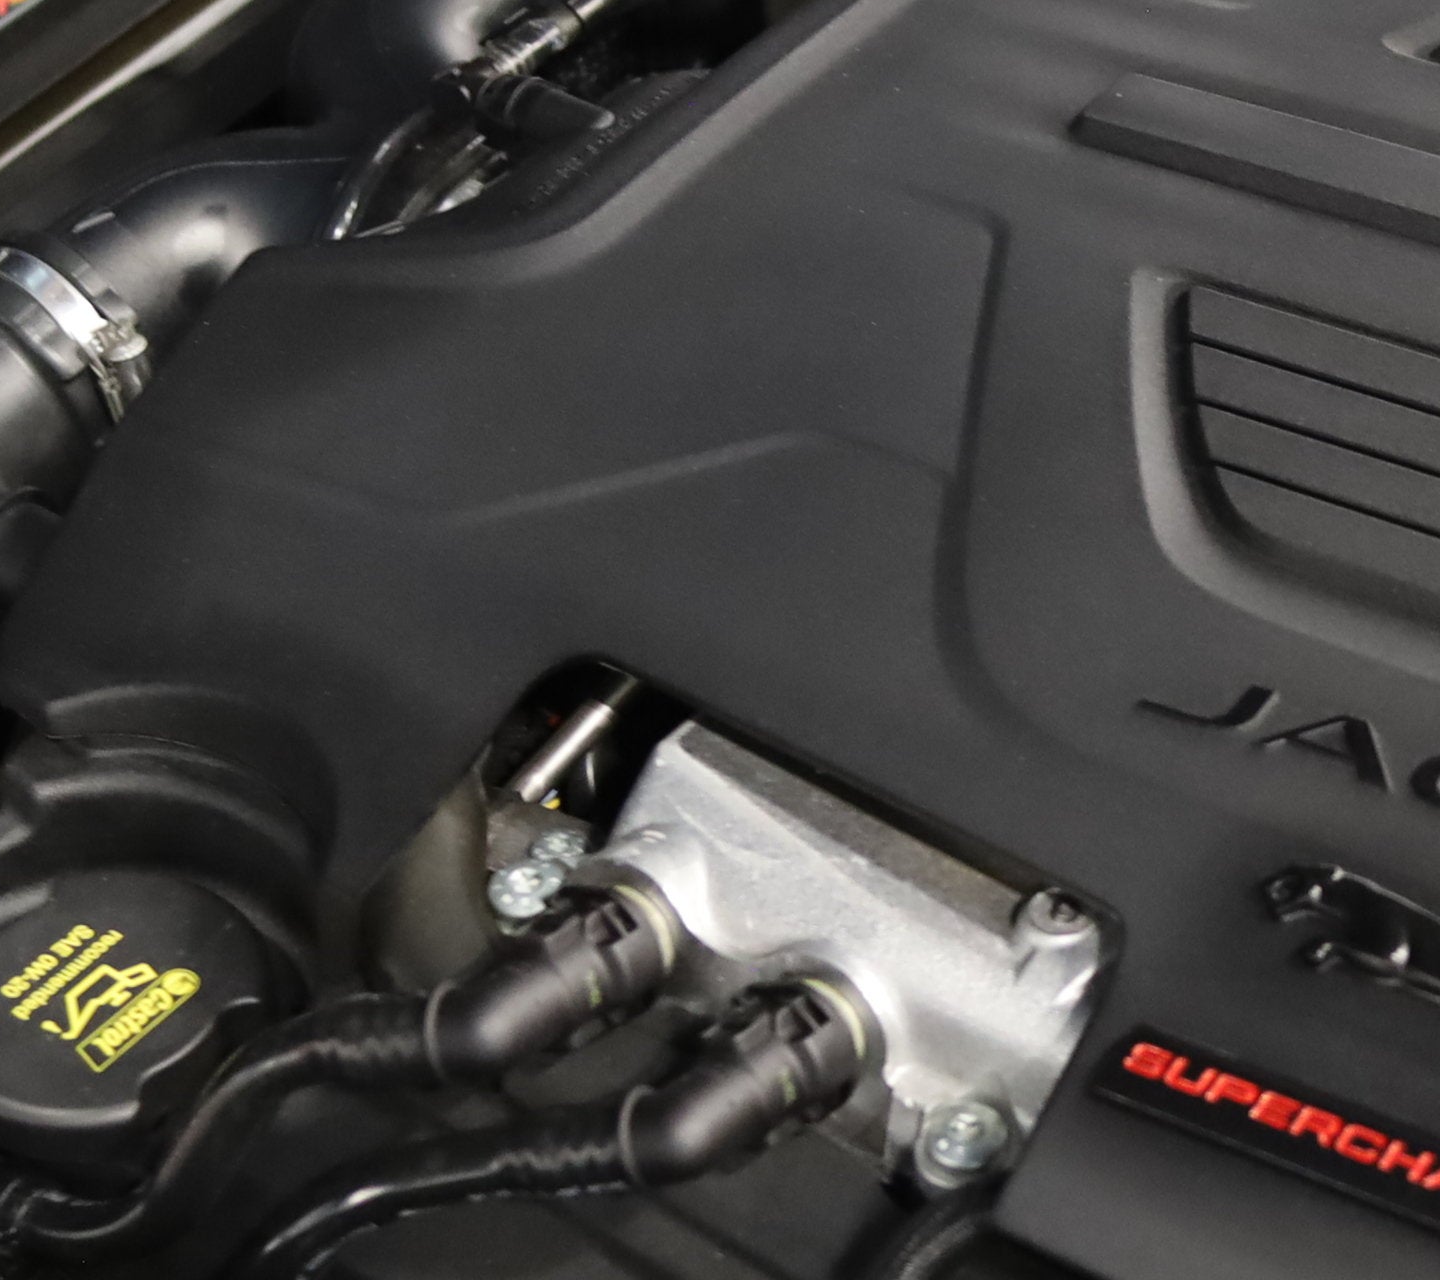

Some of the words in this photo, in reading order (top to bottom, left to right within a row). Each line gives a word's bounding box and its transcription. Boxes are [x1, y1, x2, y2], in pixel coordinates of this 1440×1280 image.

[49, 924, 96, 956] SAE
[0, 953, 59, 999] 0W-20
[10, 929, 125, 1021] recommended
[90, 990, 175, 1057] Castrol
